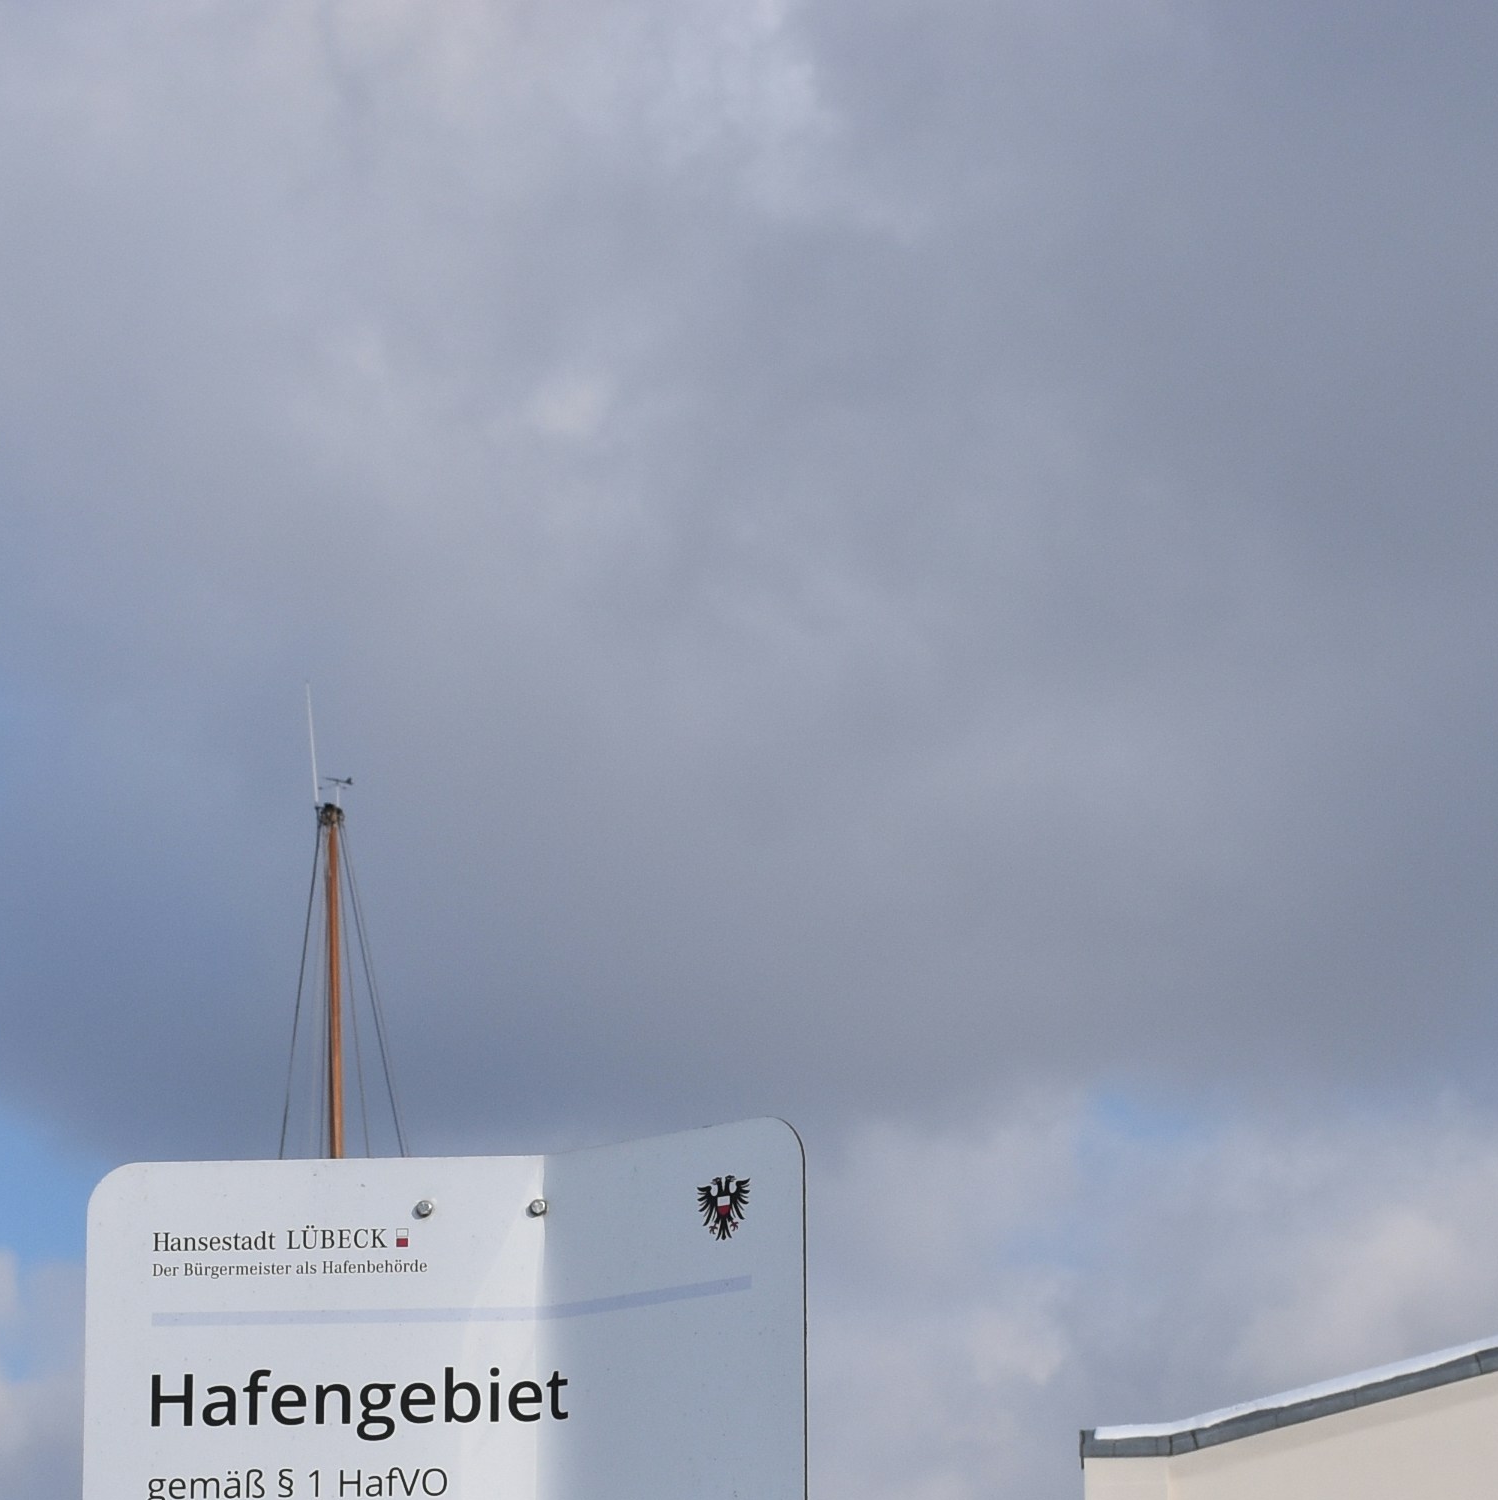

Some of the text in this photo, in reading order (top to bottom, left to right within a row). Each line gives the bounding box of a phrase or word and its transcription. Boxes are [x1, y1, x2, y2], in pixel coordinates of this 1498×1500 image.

[152, 1225, 388, 1251] Hansestadt LÜBECK
[152, 1258, 428, 1280] Der Bürgermeister als Hafenbehörde
[150, 1366, 569, 1442] Hafengebiet
[277, 1468, 294, 1499] §
[308, 1469, 320, 1498] 1
[339, 1466, 448, 1498] HafVO
